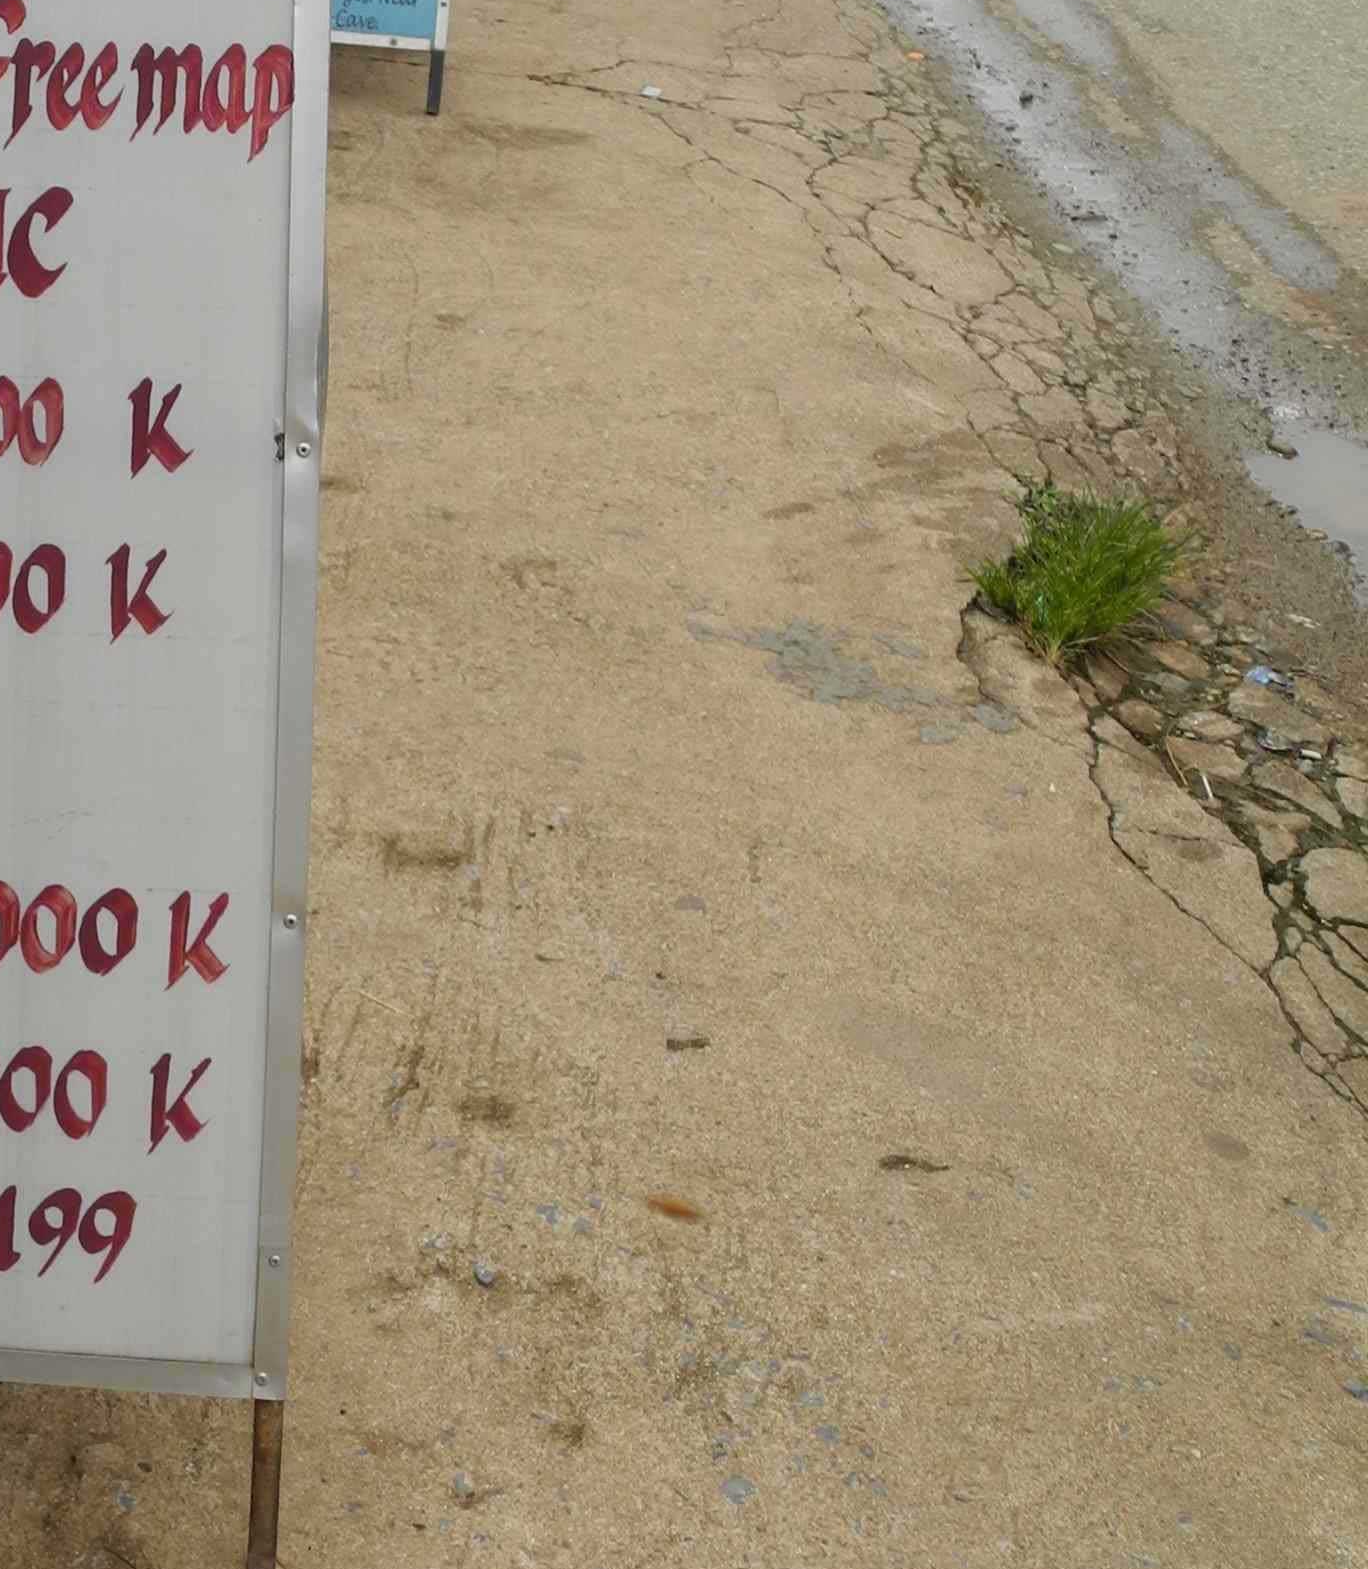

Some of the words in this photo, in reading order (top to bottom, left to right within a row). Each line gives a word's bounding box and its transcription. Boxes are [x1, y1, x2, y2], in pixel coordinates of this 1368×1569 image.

[129, 40, 294, 162] map
[127, 375, 192, 478] K
[105, 543, 172, 646] K
[165, 890, 234, 992] K
[149, 1054, 214, 1154] K
